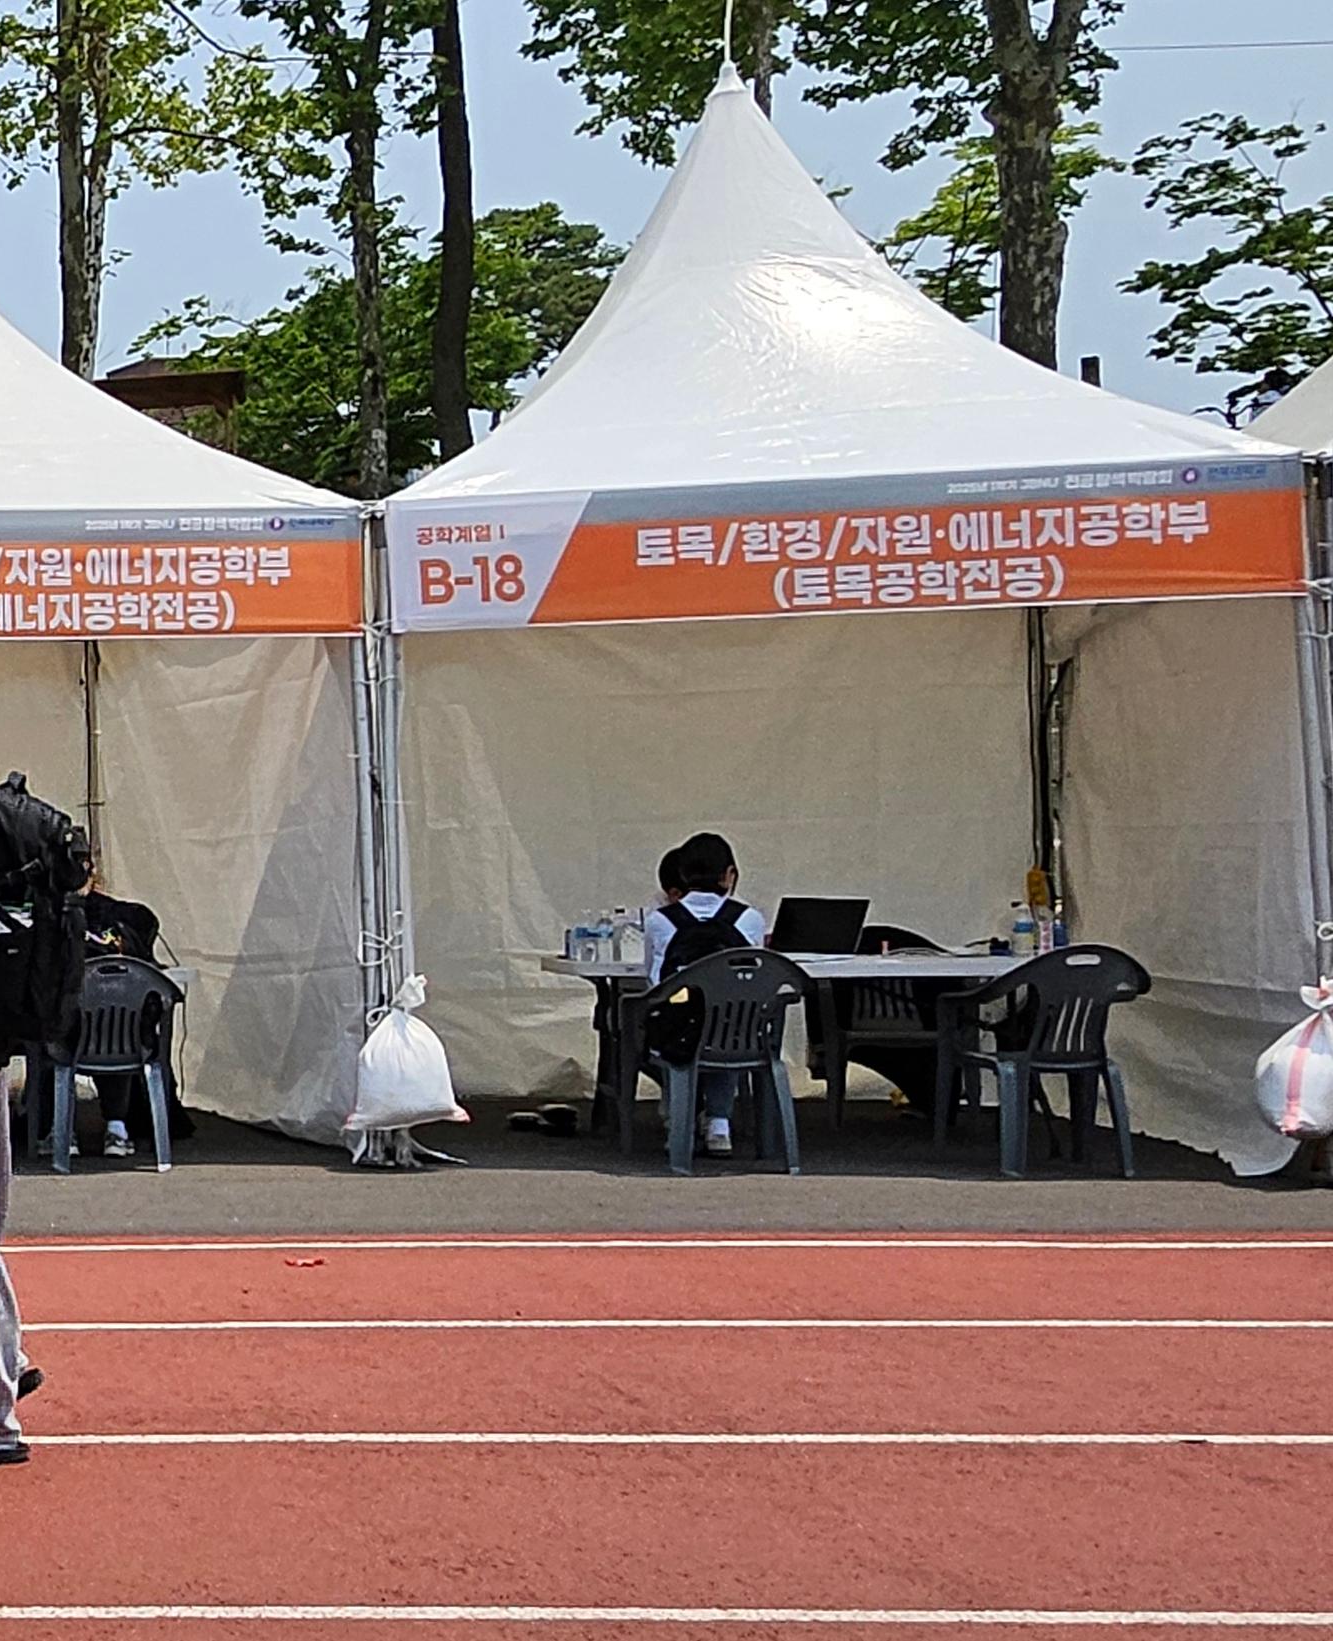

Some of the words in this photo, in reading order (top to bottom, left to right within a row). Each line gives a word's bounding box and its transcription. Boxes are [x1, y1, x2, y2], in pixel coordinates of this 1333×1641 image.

[416, 525, 491, 545] 공학계열
[419, 554, 525, 605] B-18
[773, 555, 1065, 609] (토목공학전공)
